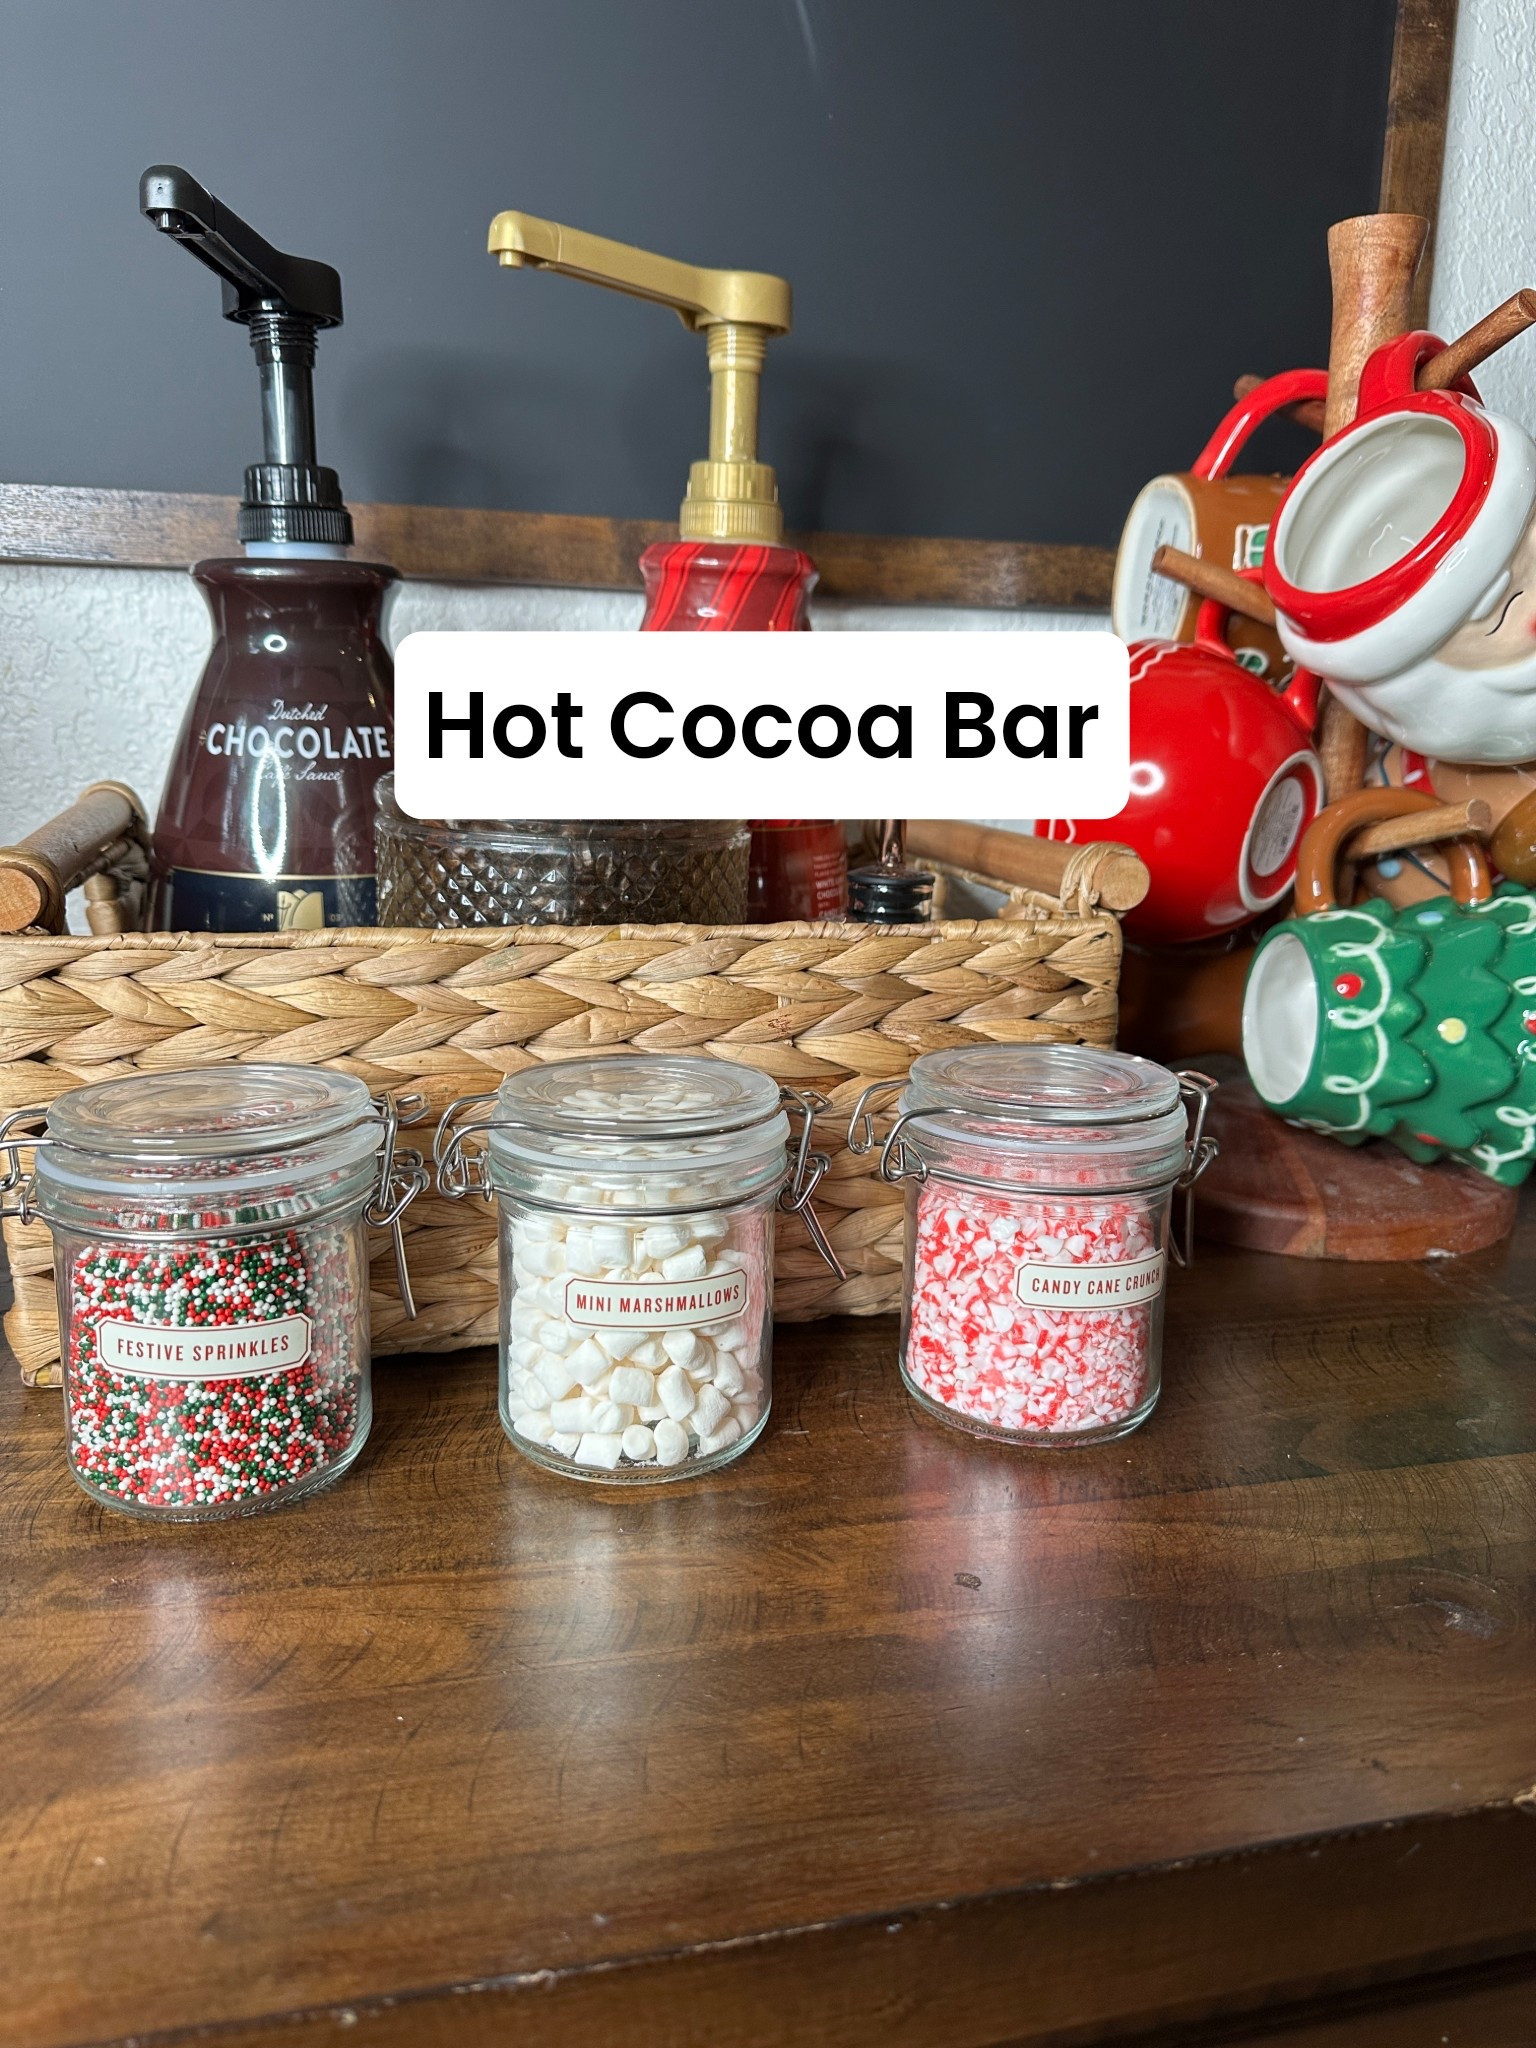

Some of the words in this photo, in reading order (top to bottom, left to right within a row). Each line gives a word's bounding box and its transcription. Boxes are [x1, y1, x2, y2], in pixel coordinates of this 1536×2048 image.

[267, 698, 327, 721] Dutched
[206, 722, 391, 759] CHOCOLATE
[295, 760, 341, 781] Sauce
[1031, 1277, 1081, 1296] CANDY
[1087, 1278, 1121, 1295] CANE
[1125, 1266, 1161, 1291] CRUNCH
[576, 1293, 612, 1313] MINI
[619, 1284, 740, 1313] MARSHMALLOWS
[117, 1337, 184, 1362] FESTIVE
[192, 1334, 290, 1362] SPRINKLES
